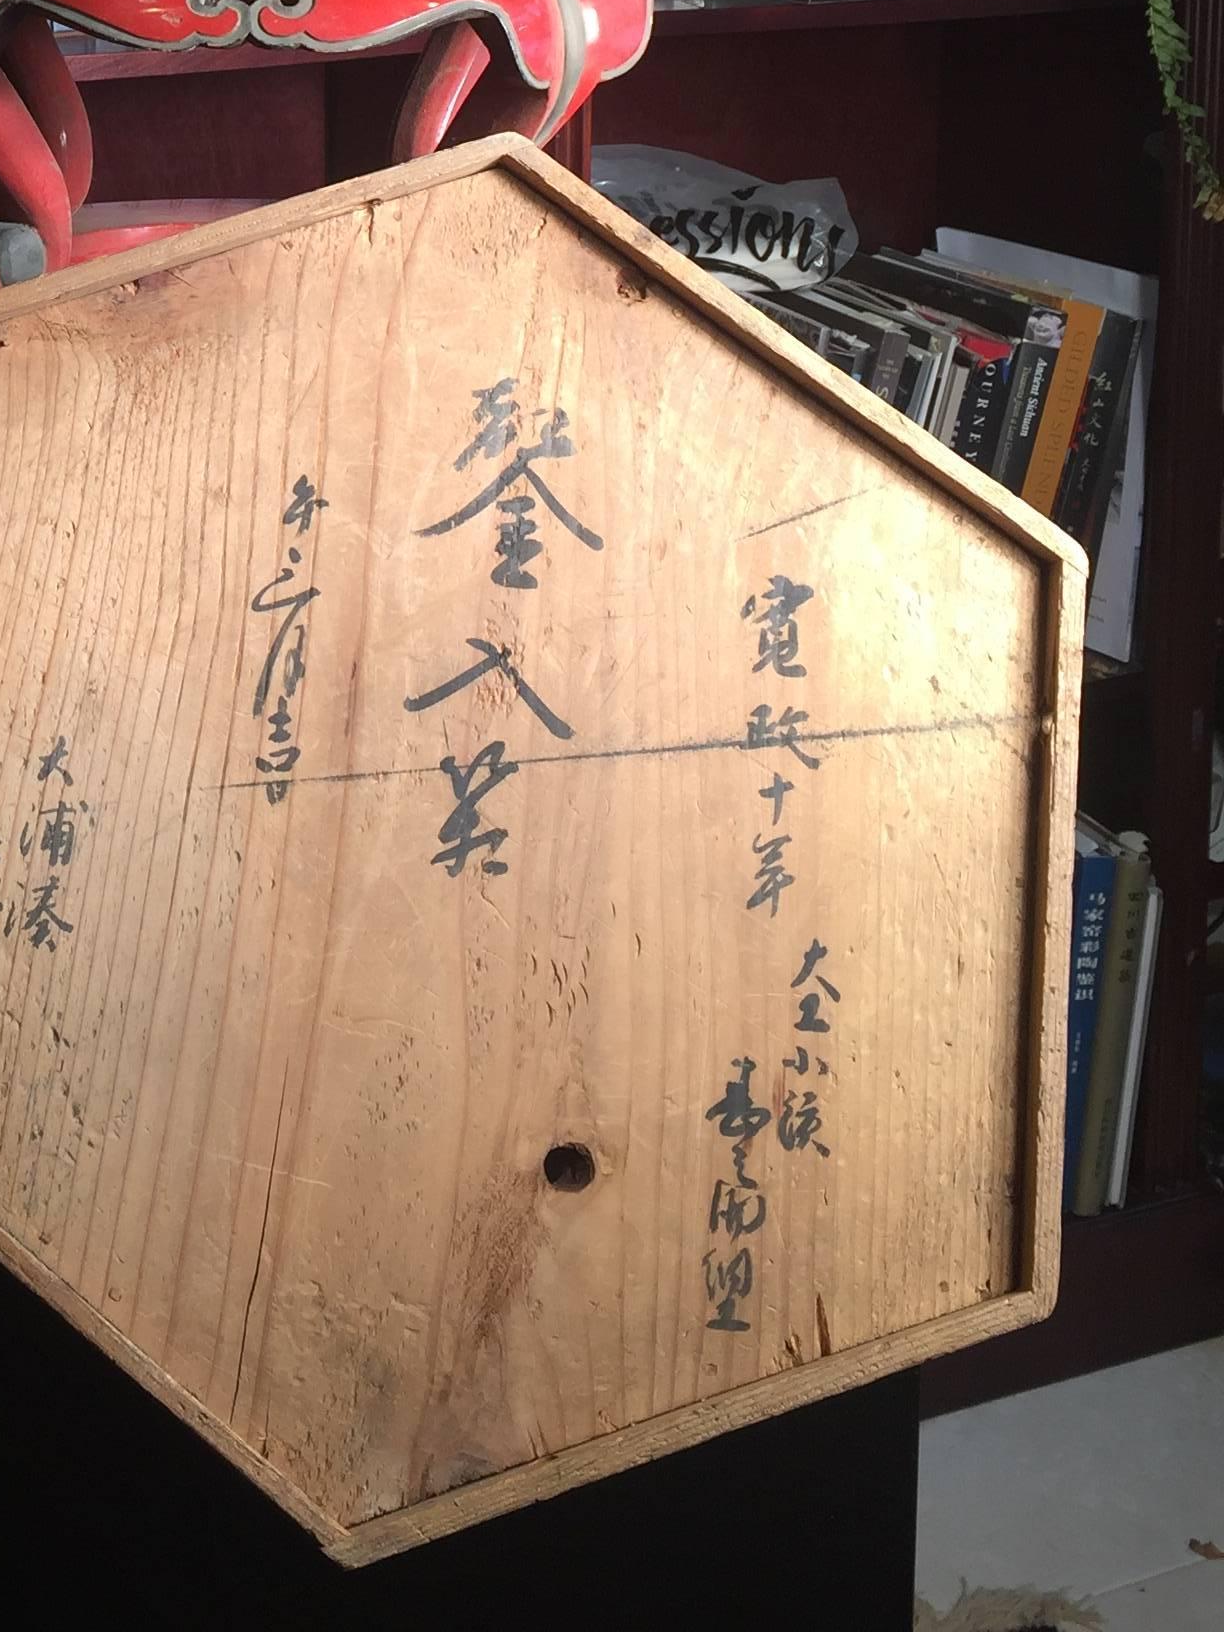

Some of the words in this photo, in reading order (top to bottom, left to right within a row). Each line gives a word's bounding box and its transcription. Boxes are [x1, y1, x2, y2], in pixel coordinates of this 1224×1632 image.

[1032, 357, 1049, 396] Ancient
[1058, 330, 1089, 415] GILDED
[965, 363, 997, 463] OURNEY
[1019, 397, 1039, 437] Sichuan
